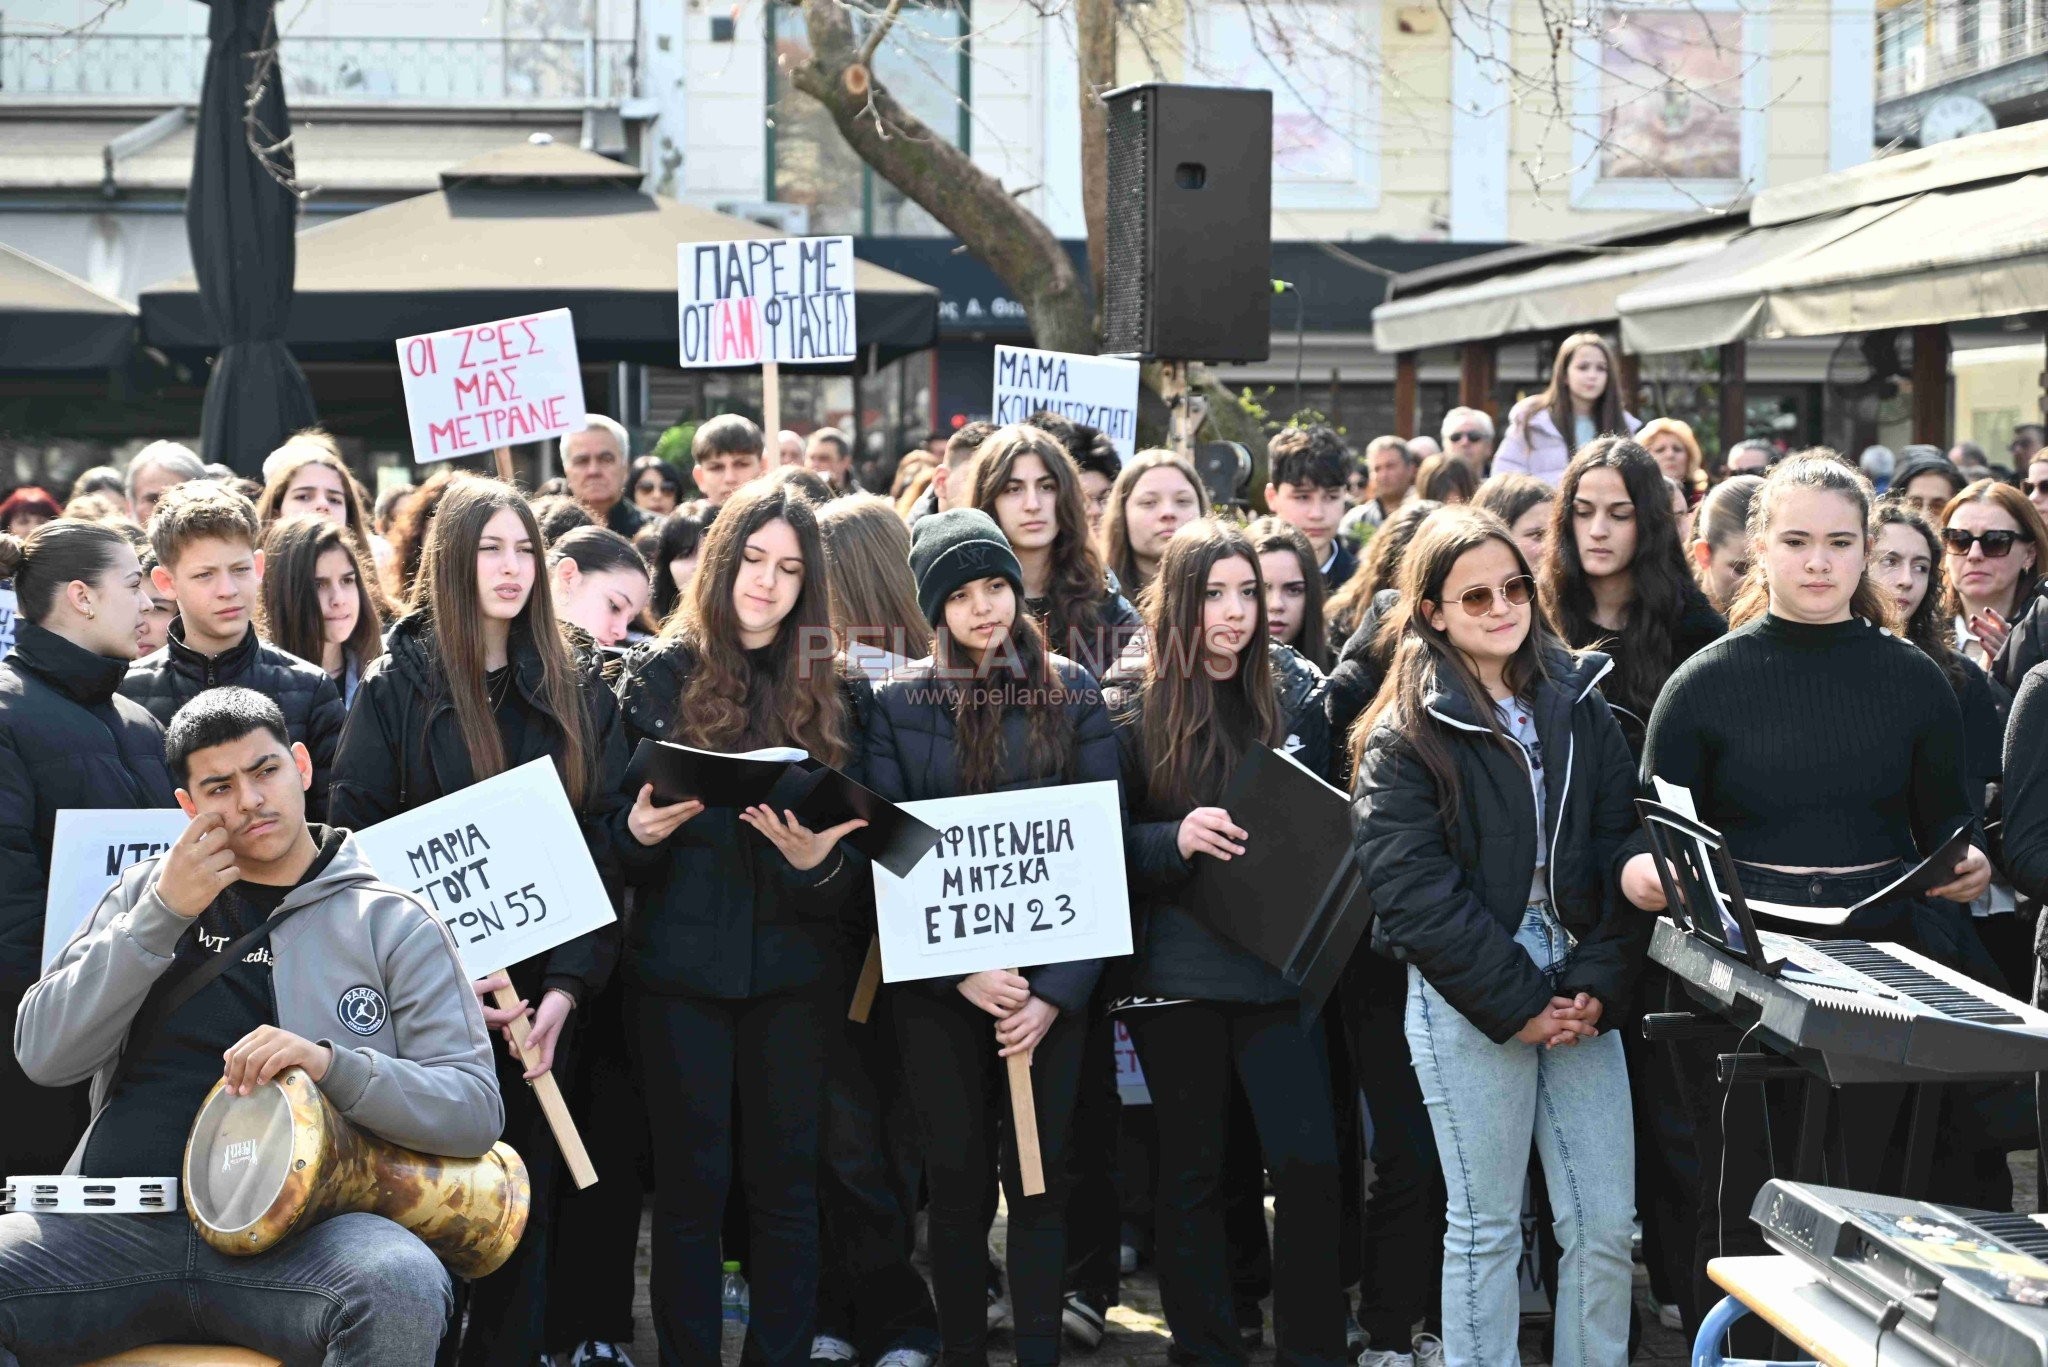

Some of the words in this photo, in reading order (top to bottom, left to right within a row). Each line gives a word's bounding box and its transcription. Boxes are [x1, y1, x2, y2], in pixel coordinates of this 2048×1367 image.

[695, 241, 789, 300] ΠΑΡΕ
[800, 240, 842, 294] ΜΕ
[407, 337, 437, 377] ΟΙ
[452, 318, 544, 369] ΖΩΕΣ
[765, 291, 857, 360] ΦΤΑΣΕΙΣ
[454, 365, 522, 411] ΜΑΣ
[999, 350, 1068, 393] ΜΑΜΑ
[429, 395, 569, 454] ΜΕΤΡΑΝΕ
[406, 823, 490, 878] ΜΑΡΙΑ
[942, 857, 1050, 898] ΜΗΤΣΚΑ
[504, 882, 547, 927] 55
[925, 902, 1014, 944] ΕΤΩΝ
[1027, 894, 1076, 931] 23
[344, 989, 377, 1003] PARIS
